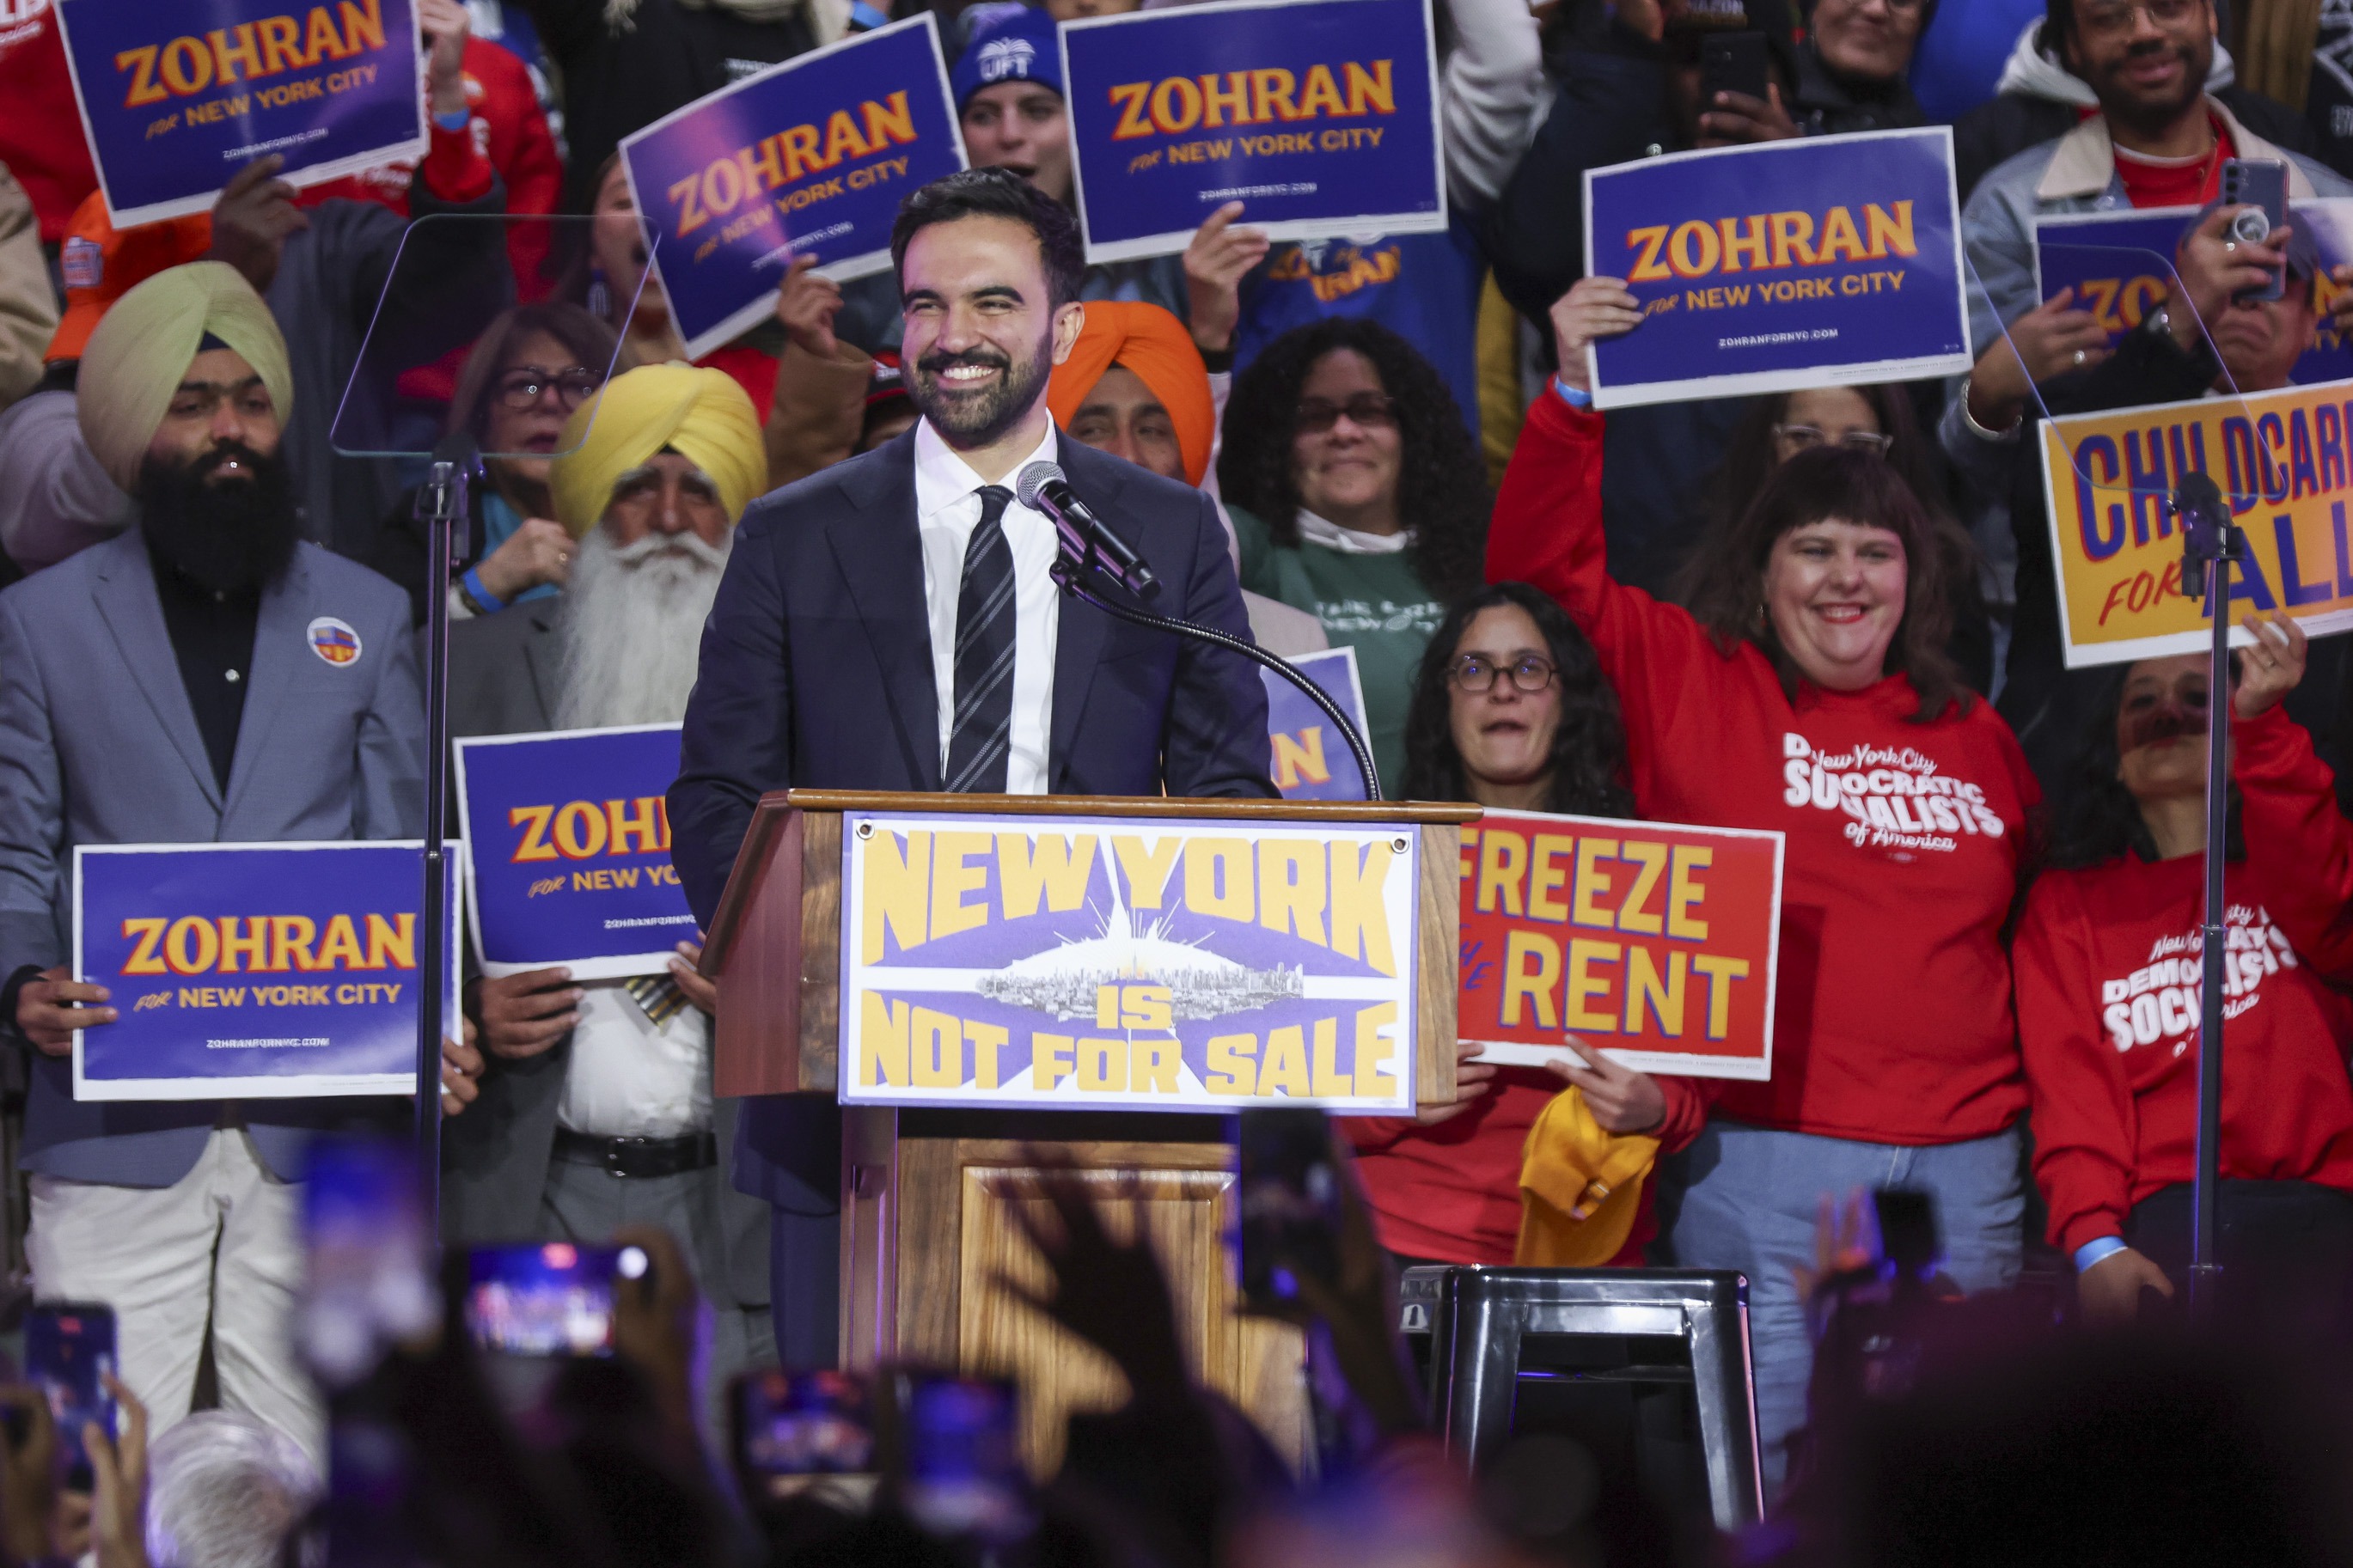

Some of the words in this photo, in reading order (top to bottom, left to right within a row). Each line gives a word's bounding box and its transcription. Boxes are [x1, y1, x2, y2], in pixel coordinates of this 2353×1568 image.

[113, 0, 387, 108] ZOHRAN
[185, 95, 251, 127] NEW
[255, 76, 323, 109] YORK
[326, 64, 378, 94] CITY
[1109, 59, 1397, 141] ZOHRAN
[668, 89, 918, 239] ZOHRAN
[1168, 138, 1233, 165] NEW
[1240, 131, 1315, 156] YORK
[1319, 128, 1384, 152] CITY
[721, 204, 773, 244] NEW
[776, 176, 845, 214] YORK
[847, 156, 908, 190] CITY
[1626, 199, 1918, 284] ZOHRAN
[1644, 294, 1680, 318] FOR
[1686, 284, 1751, 310] NEW
[1757, 278, 1835, 302] YORK
[1841, 270, 1905, 295] CITY
[1719, 328, 1838, 348] ZOHRANFORNYC.COM
[2073, 400, 2353, 563] CHIDCAR
[2099, 560, 2183, 626] FOR
[1854, 742, 1900, 770] York
[1900, 747, 1937, 775] City
[509, 796, 671, 863] ZOH
[1844, 821, 1870, 847] of
[1872, 829, 1957, 851] America
[528, 876, 566, 898] FOR
[572, 868, 639, 892] NEW
[645, 864, 681, 886] YO
[862, 830, 1098, 966] NEW
[1112, 837, 1397, 979] YORK
[1458, 827, 1713, 942] FREEZE
[119, 912, 417, 976] ZOHRAN
[133, 991, 173, 1012] FOR
[179, 987, 246, 1009] NEW
[252, 985, 331, 1006] YORK
[336, 983, 402, 1005] CITY
[1097, 985, 1172, 1030] IS
[1458, 923, 1494, 990] HE
[1498, 930, 1749, 1040] RENT
[860, 989, 1008, 1089] NOT
[1032, 1034, 1182, 1093] FOR
[1204, 1000, 1397, 1097] SALE
